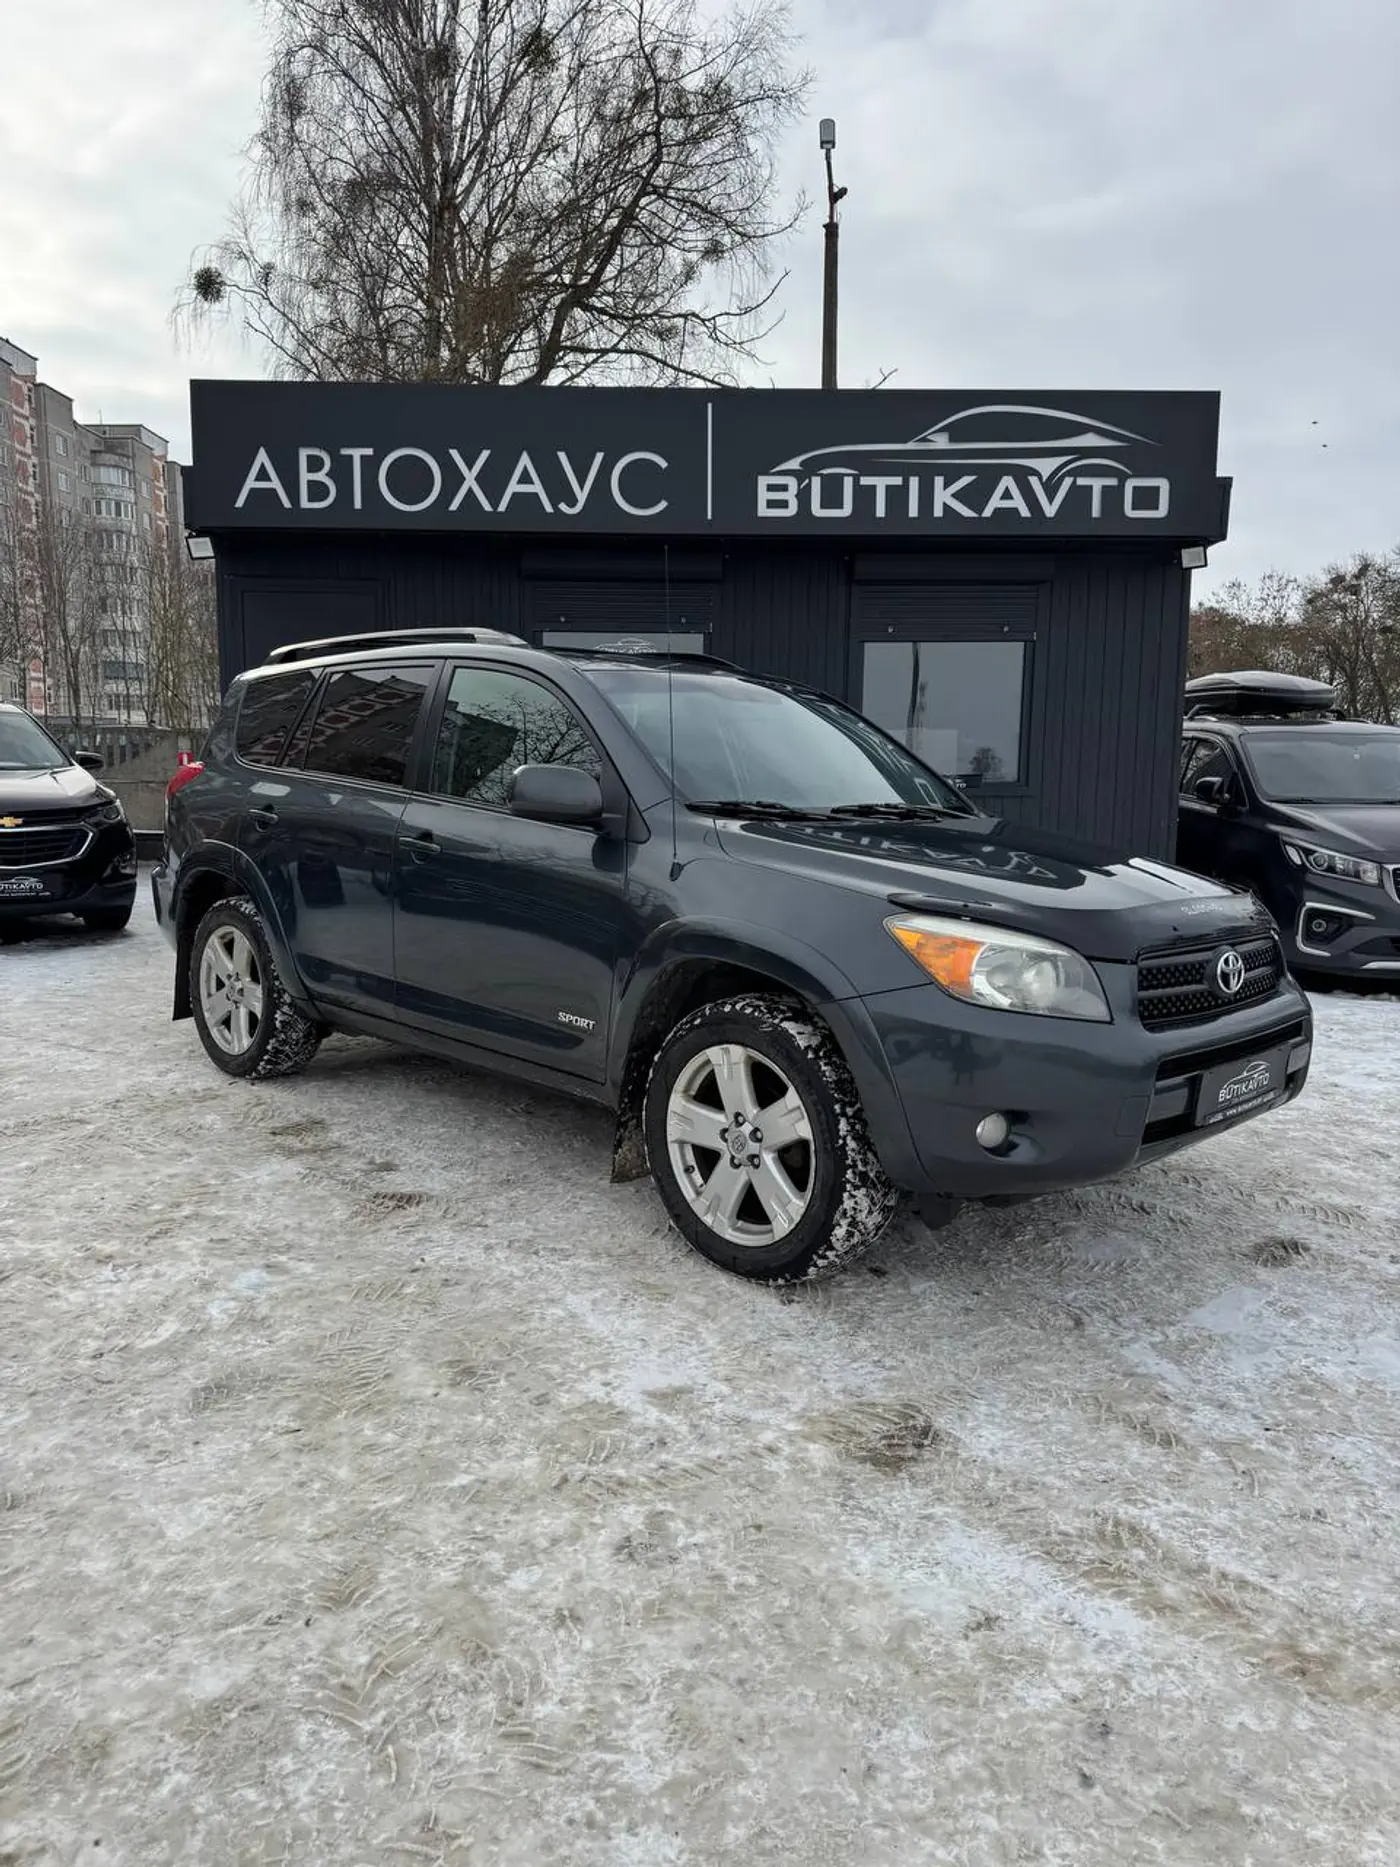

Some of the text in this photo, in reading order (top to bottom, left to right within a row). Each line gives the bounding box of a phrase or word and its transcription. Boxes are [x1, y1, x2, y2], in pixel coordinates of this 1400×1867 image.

[234, 445, 669, 516] АВТОХАУС
[756, 474, 1170, 519] BUTIKAVTO
[558, 1011, 596, 1030] SPORT
[1217, 1071, 1270, 1102] BUTIKAVTO
